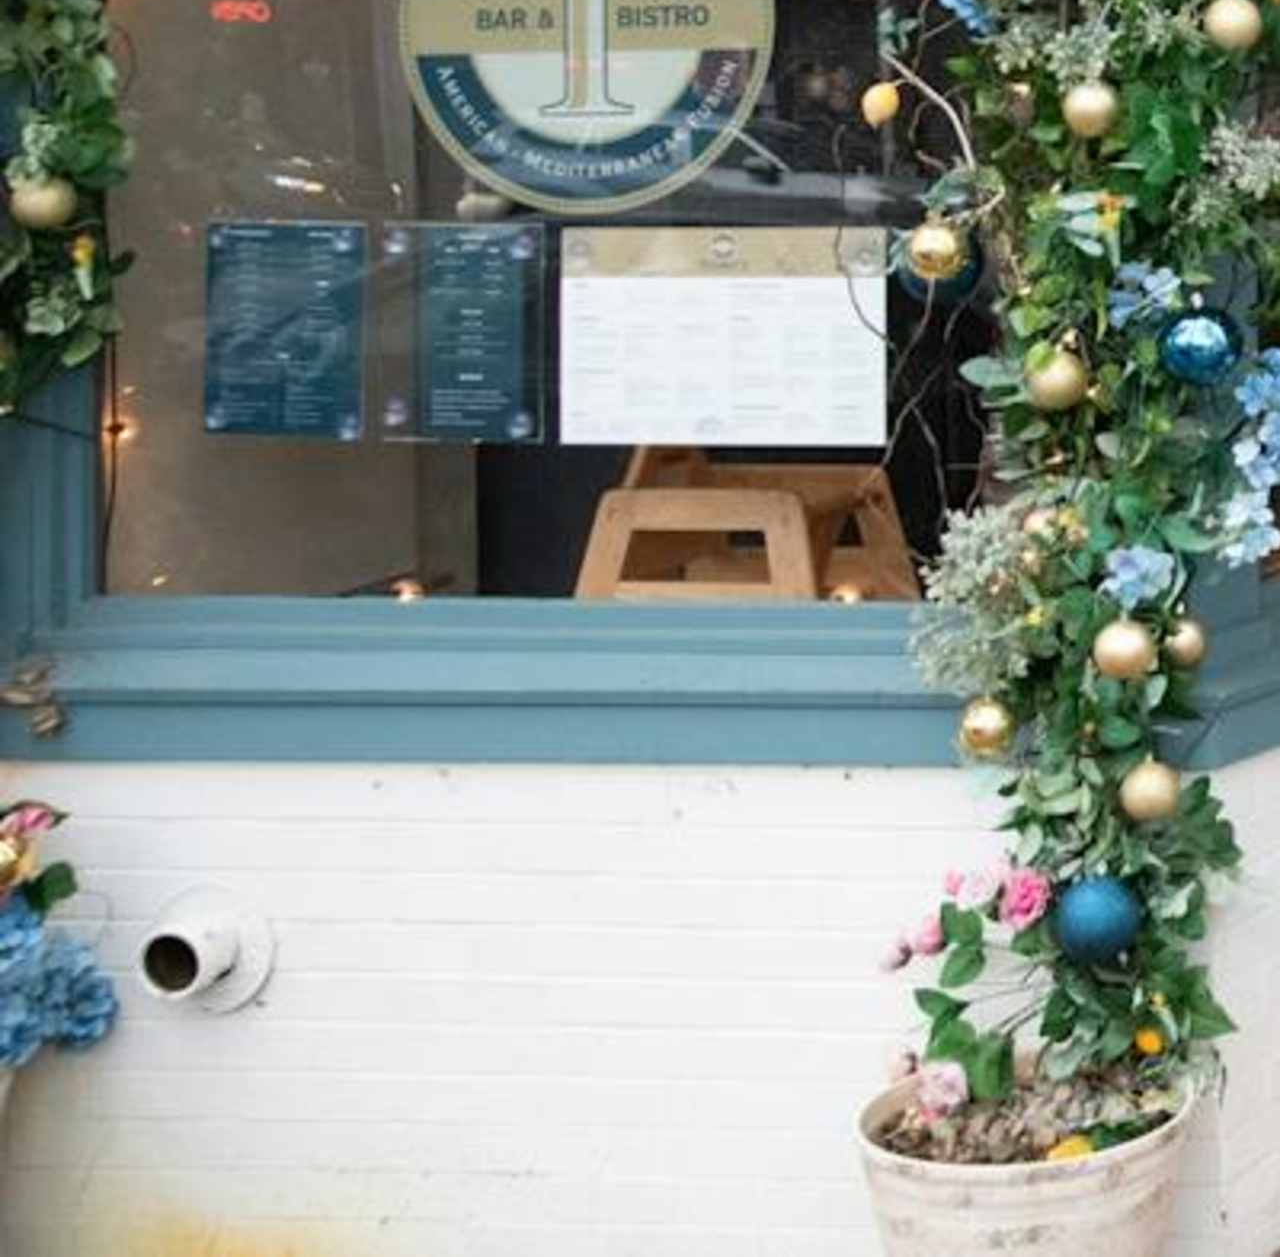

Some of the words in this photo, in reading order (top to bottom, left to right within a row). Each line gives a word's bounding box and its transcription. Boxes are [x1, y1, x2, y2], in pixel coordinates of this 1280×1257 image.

[475, 9, 526, 31] BAR
[539, 10, 554, 29] &
[617, 5, 709, 28] BISTRO
[436, 66, 507, 154] AMERICAN
[687, 59, 739, 130] FUSION
